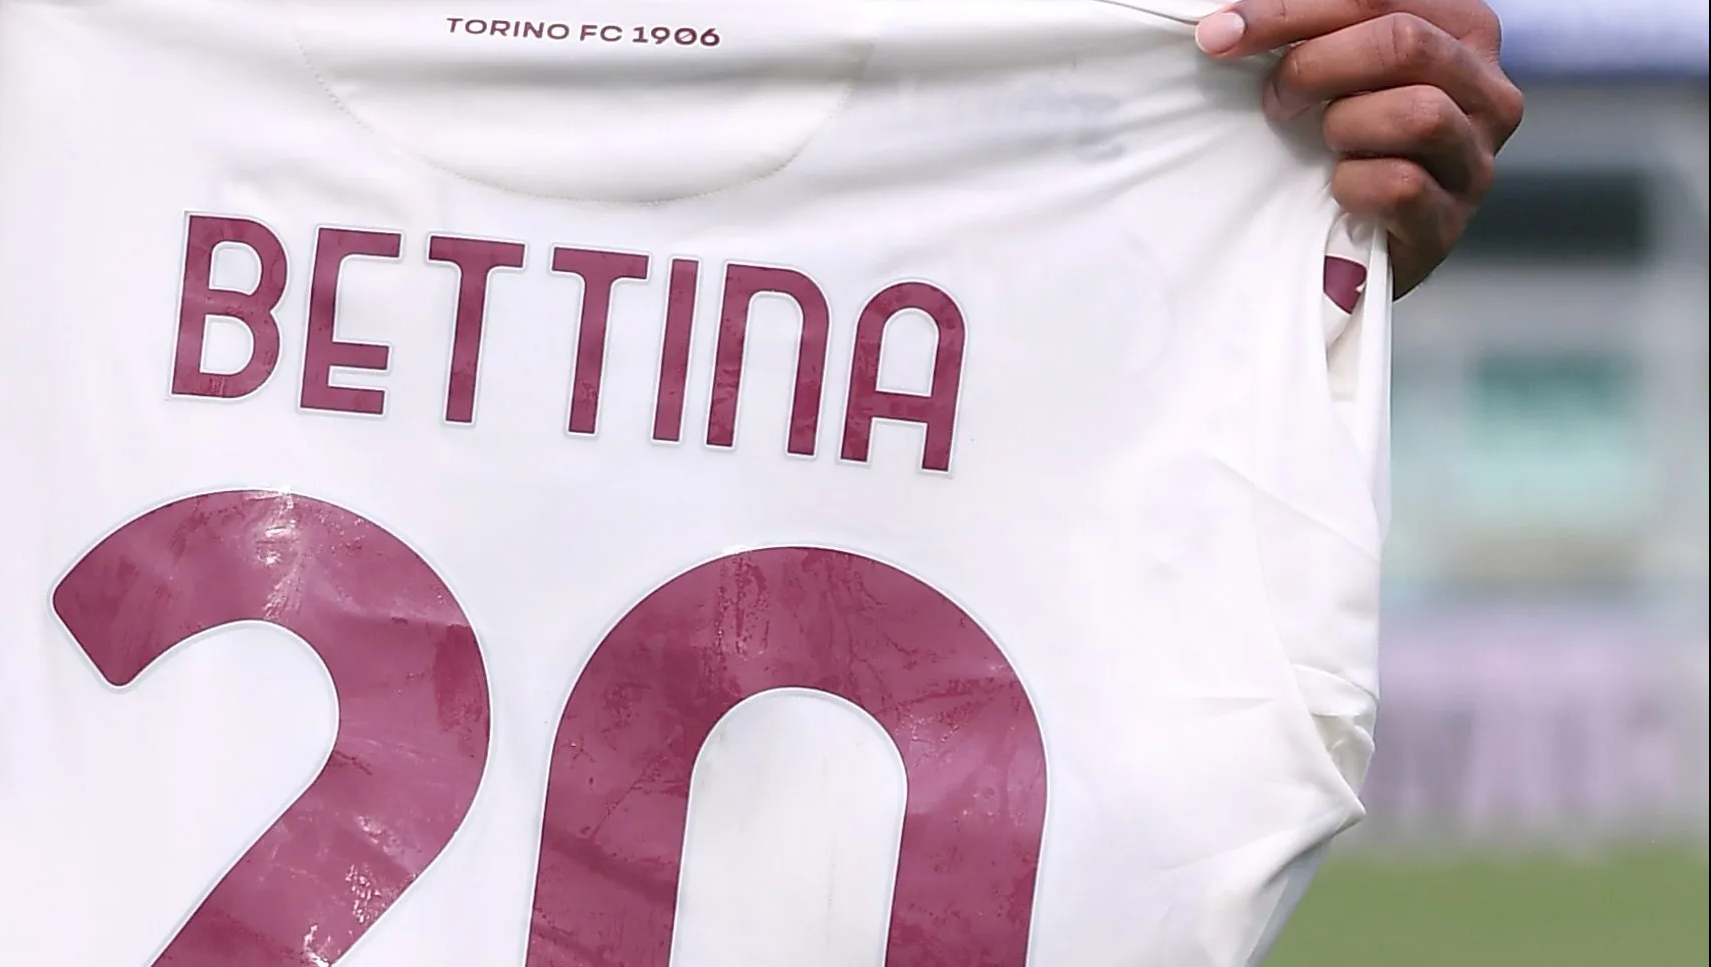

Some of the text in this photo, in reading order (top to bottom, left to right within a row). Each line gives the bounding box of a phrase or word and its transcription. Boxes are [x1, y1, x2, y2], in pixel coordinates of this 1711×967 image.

[447, 17, 721, 48] TORINO FC 1906
[170, 213, 967, 472] BETTINA
[52, 489, 1049, 967] 20
